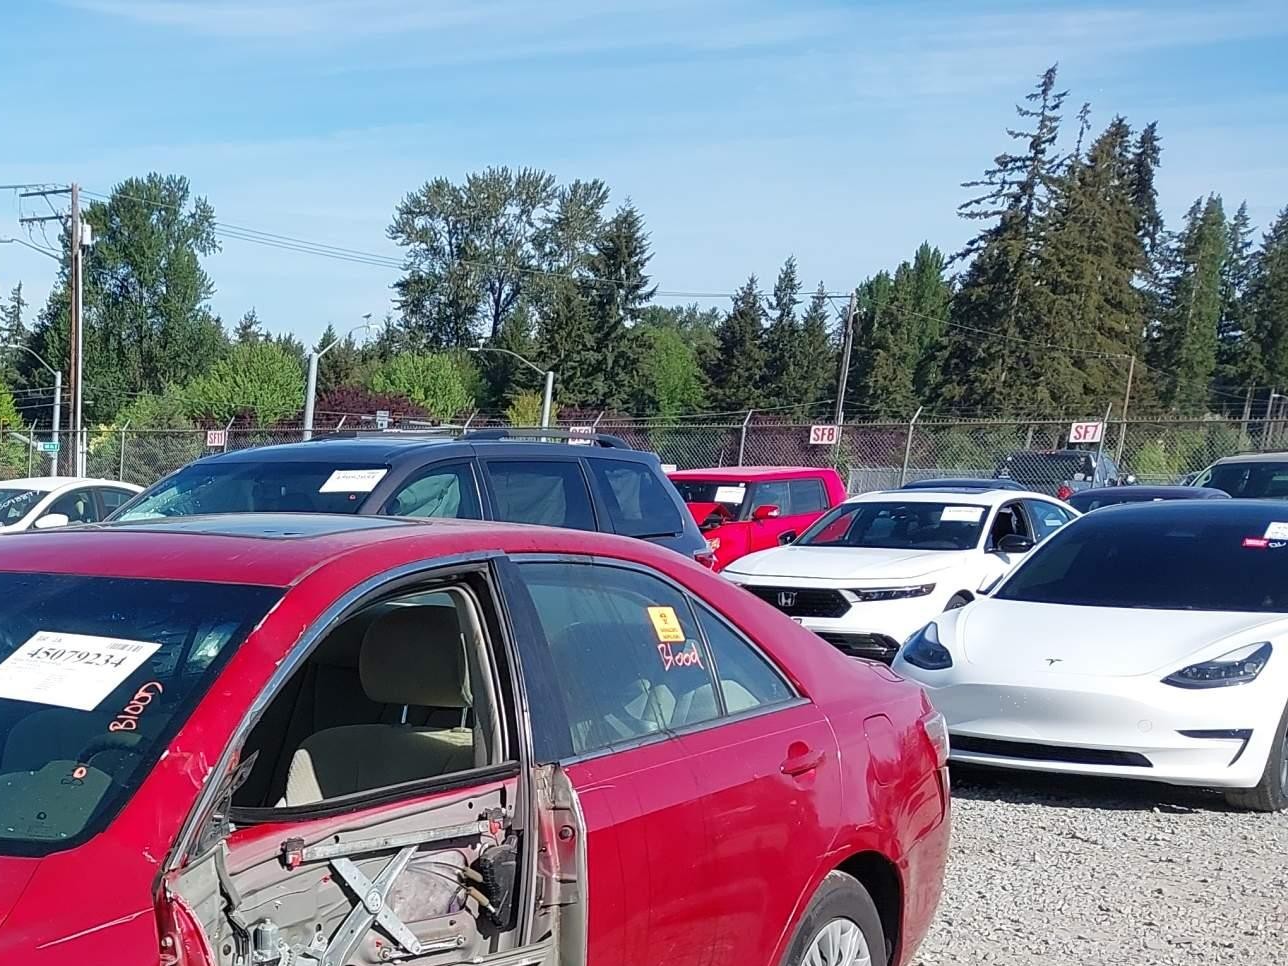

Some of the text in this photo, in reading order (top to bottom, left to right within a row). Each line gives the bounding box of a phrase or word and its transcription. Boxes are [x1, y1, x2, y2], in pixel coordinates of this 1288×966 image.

[208, 432, 223, 445] SF11
[812, 427, 835, 442] SF8
[1073, 424, 1099, 440] SF7
[27, 646, 127, 668] 45079234
[656, 642, 705, 672] Blood
